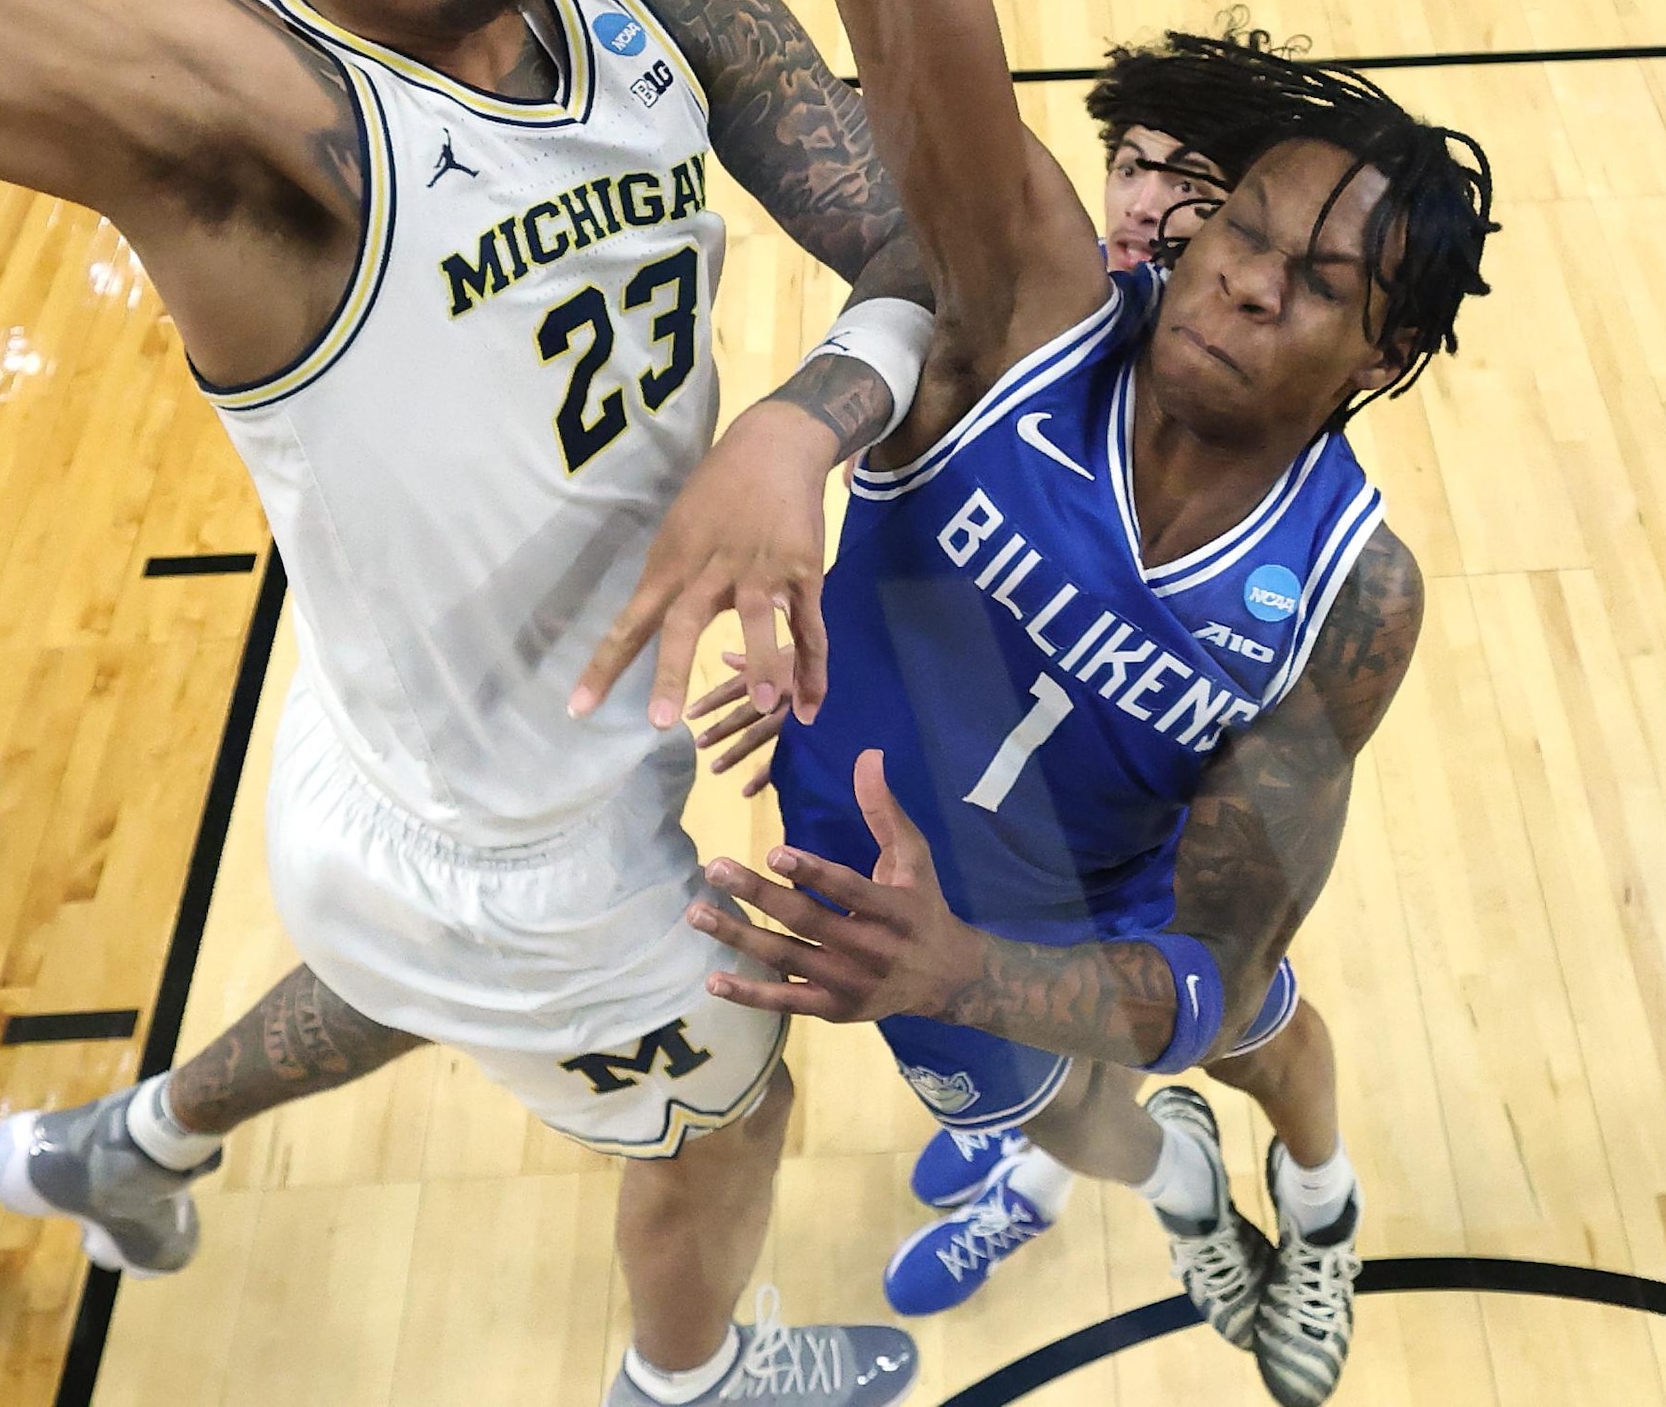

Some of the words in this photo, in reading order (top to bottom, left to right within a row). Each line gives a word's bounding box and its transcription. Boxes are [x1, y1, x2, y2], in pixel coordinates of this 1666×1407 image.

[611, 21, 642, 51] NCAA
[536, 244, 701, 478] 23
[936, 487, 1259, 753] BILLIKENS
[1248, 586, 1298, 614] NCAA
[1191, 620, 1276, 664] A10
[962, 670, 1075, 814] 1
[558, 1016, 713, 1094] M
